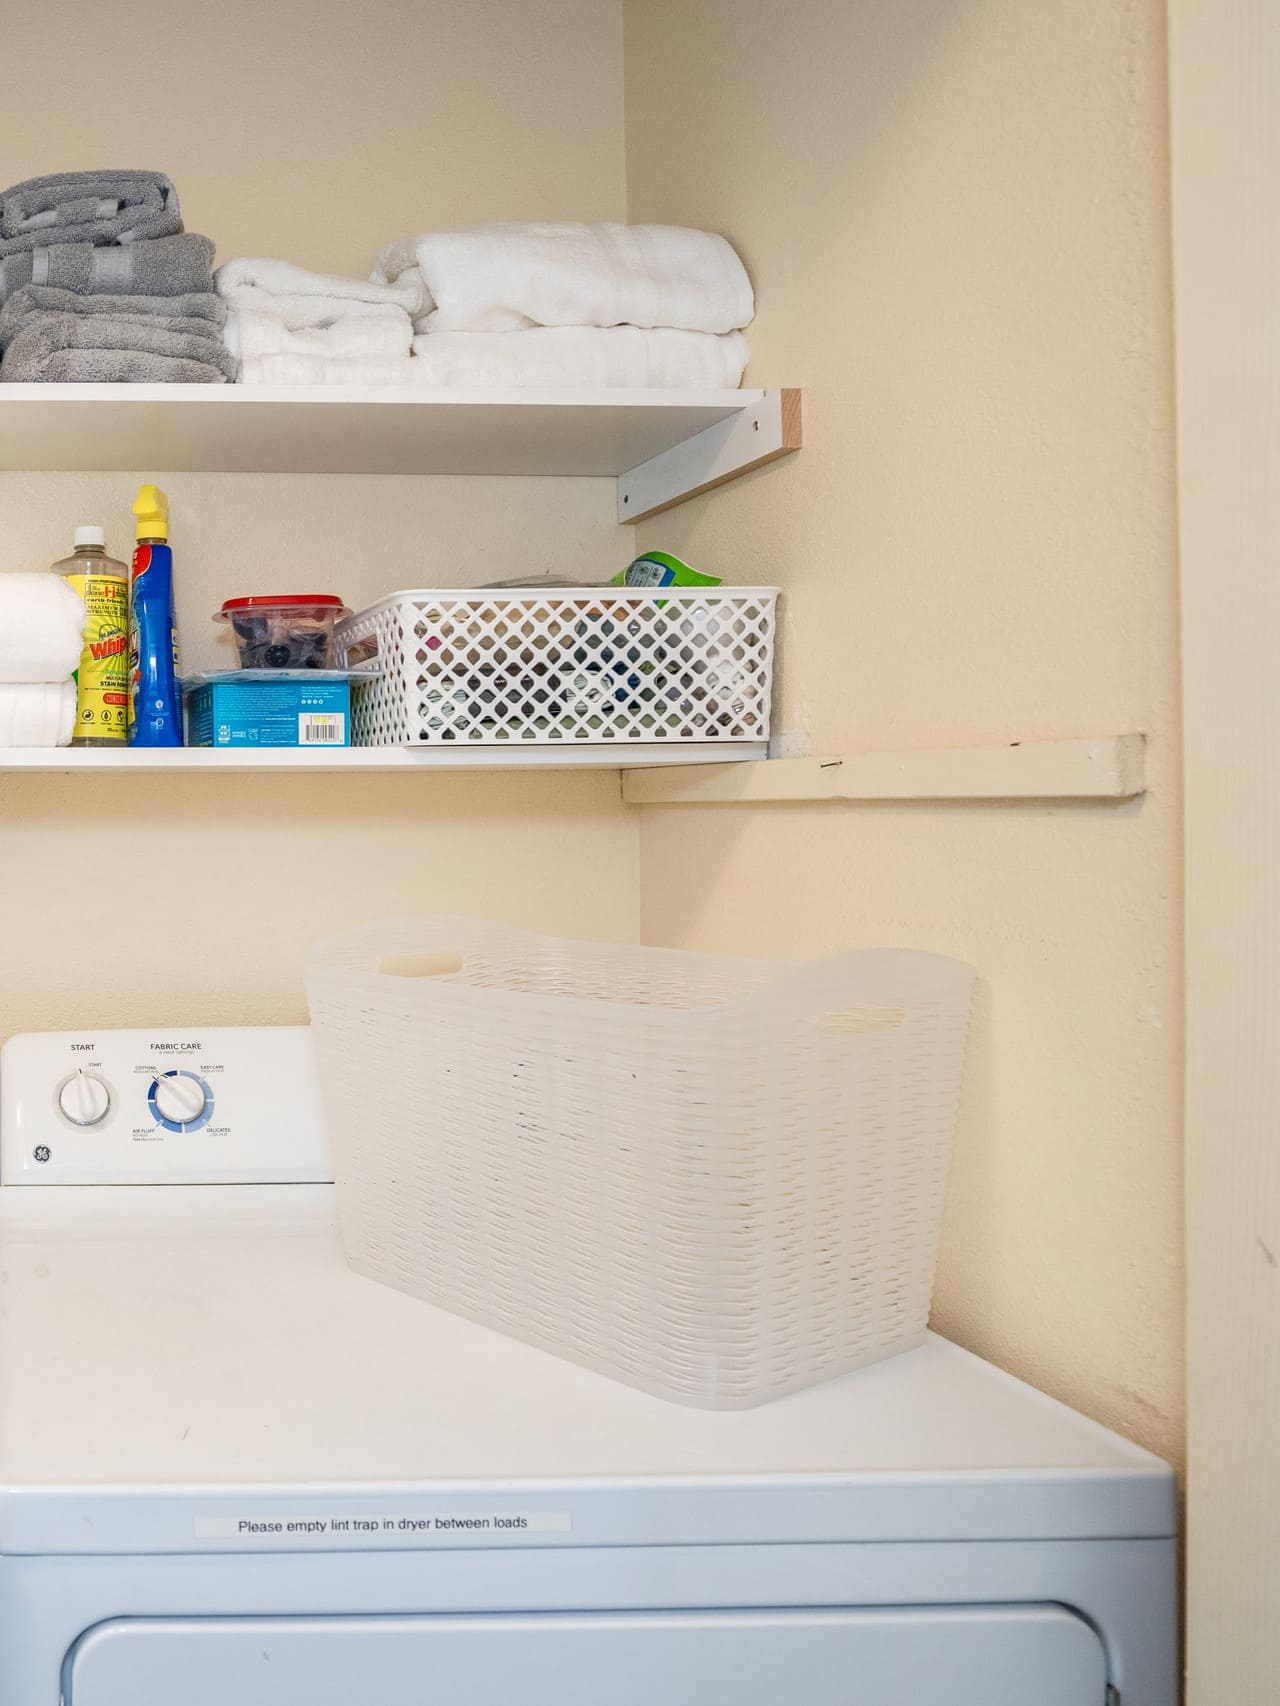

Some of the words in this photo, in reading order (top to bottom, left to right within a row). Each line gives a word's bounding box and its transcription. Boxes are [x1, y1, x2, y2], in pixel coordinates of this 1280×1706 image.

[238, 1520, 283, 1533] Please
[286, 1520, 326, 1532] empty
[331, 1519, 349, 1531] lint
[353, 1519, 379, 1532] trap
[383, 1518, 394, 1530] in
[398, 1518, 432, 1532] dryer
[435, 1517, 490, 1529] between
[494, 1516, 528, 1528] loads
